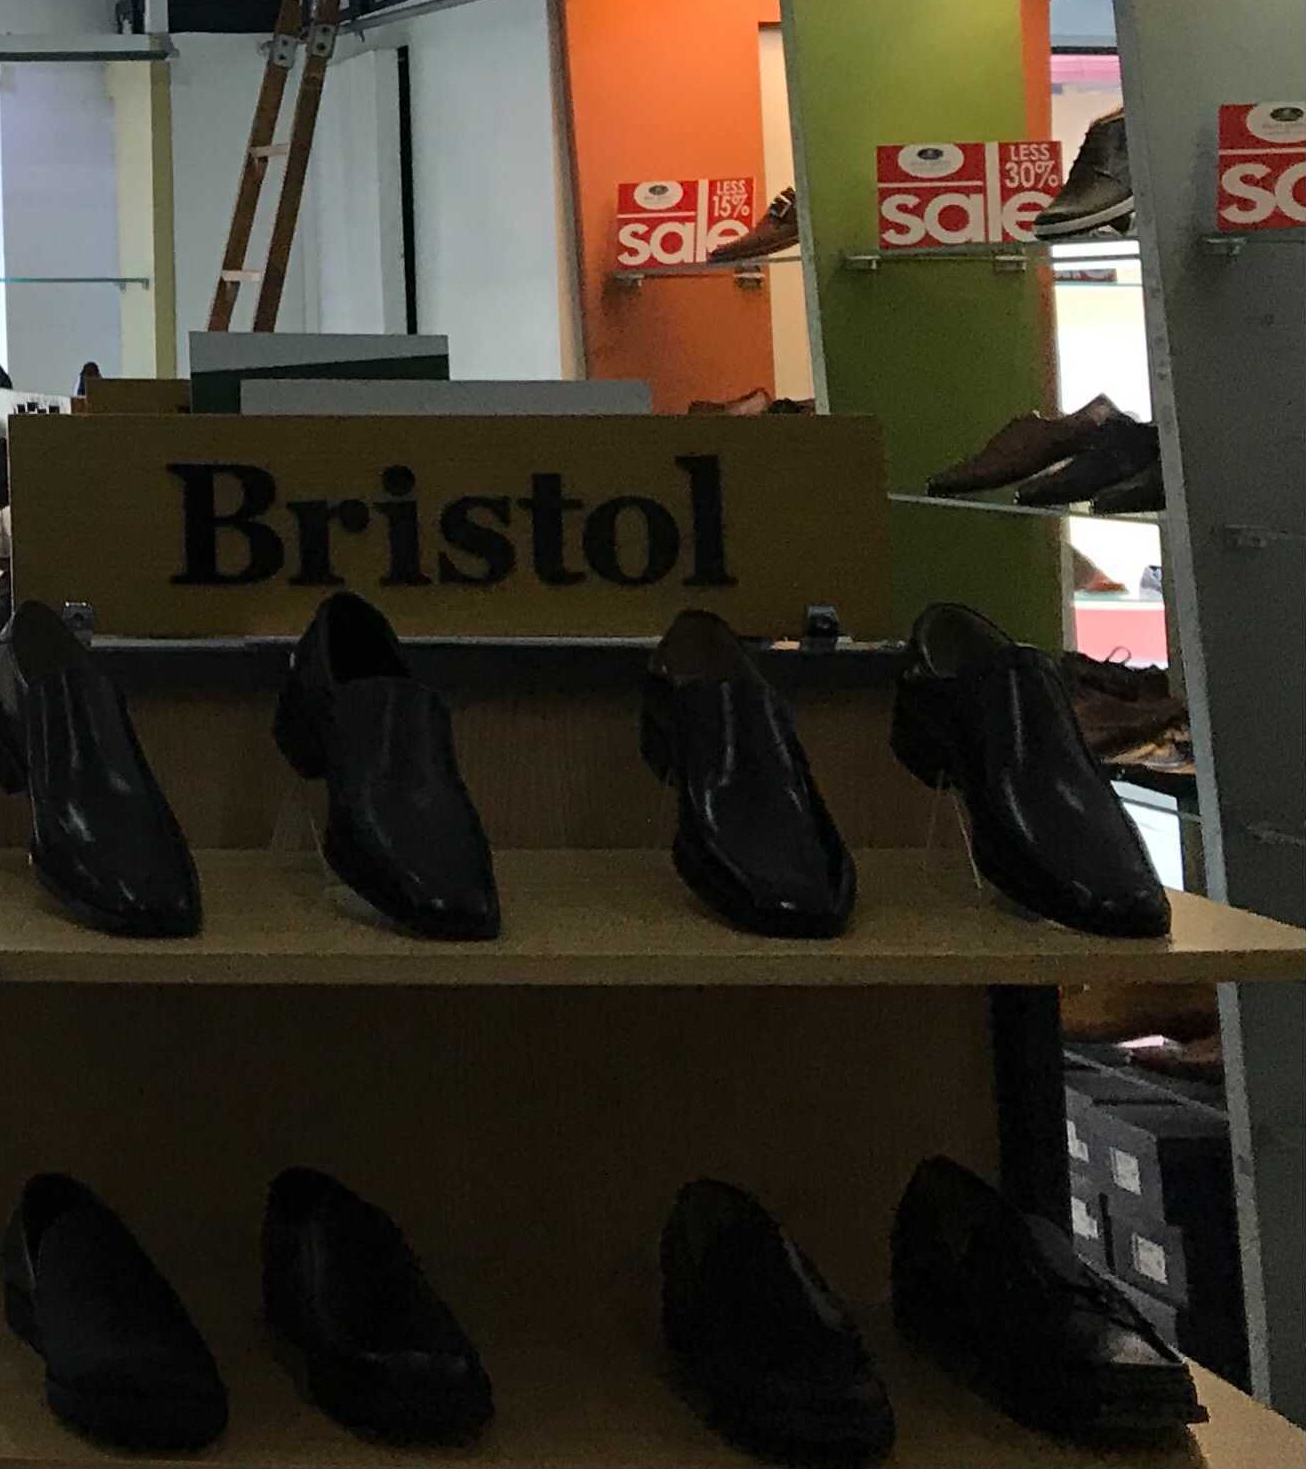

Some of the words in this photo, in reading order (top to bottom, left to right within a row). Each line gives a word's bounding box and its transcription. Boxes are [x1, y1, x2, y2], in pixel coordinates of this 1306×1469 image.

[1010, 144, 1050, 161] LESS
[717, 179, 746, 195] LESS
[1005, 160, 1059, 189] 30%
[712, 193, 750, 218] 15%
[165, 454, 739, 587] Bristol
